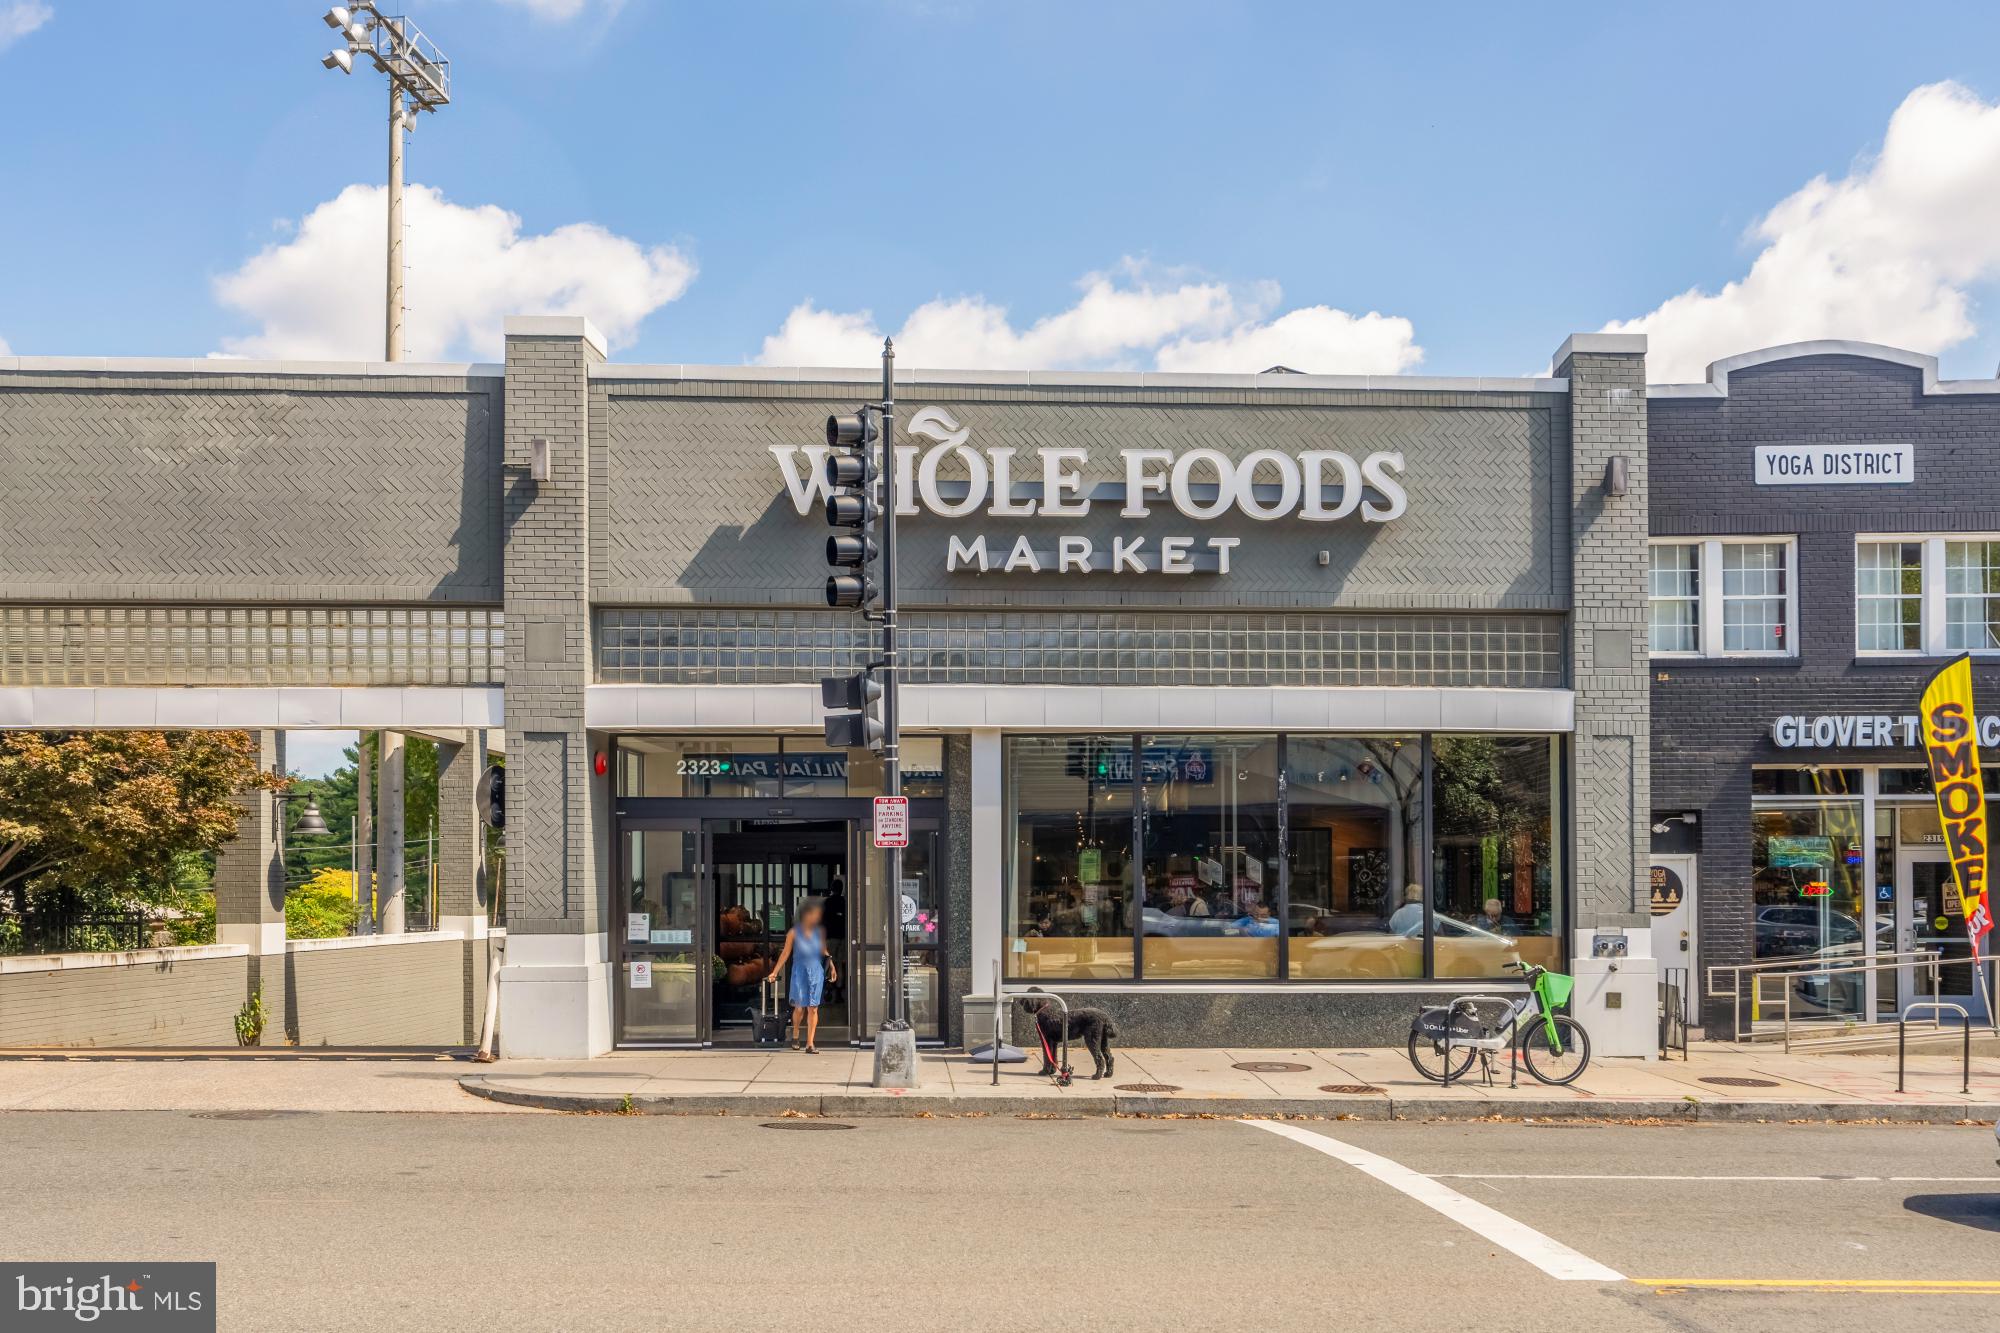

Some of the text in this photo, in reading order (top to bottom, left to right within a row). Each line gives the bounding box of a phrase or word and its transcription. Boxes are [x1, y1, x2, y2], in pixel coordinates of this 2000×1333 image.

[769, 406, 1407, 523] WHOLE FOODS
[1766, 452, 1904, 475] YOGA DISTRICT
[947, 535, 1241, 574] MARKET
[1774, 715, 1894, 748] GLOVER
[676, 759, 721, 775] 2323
[1929, 702, 1985, 899] SMOKE
